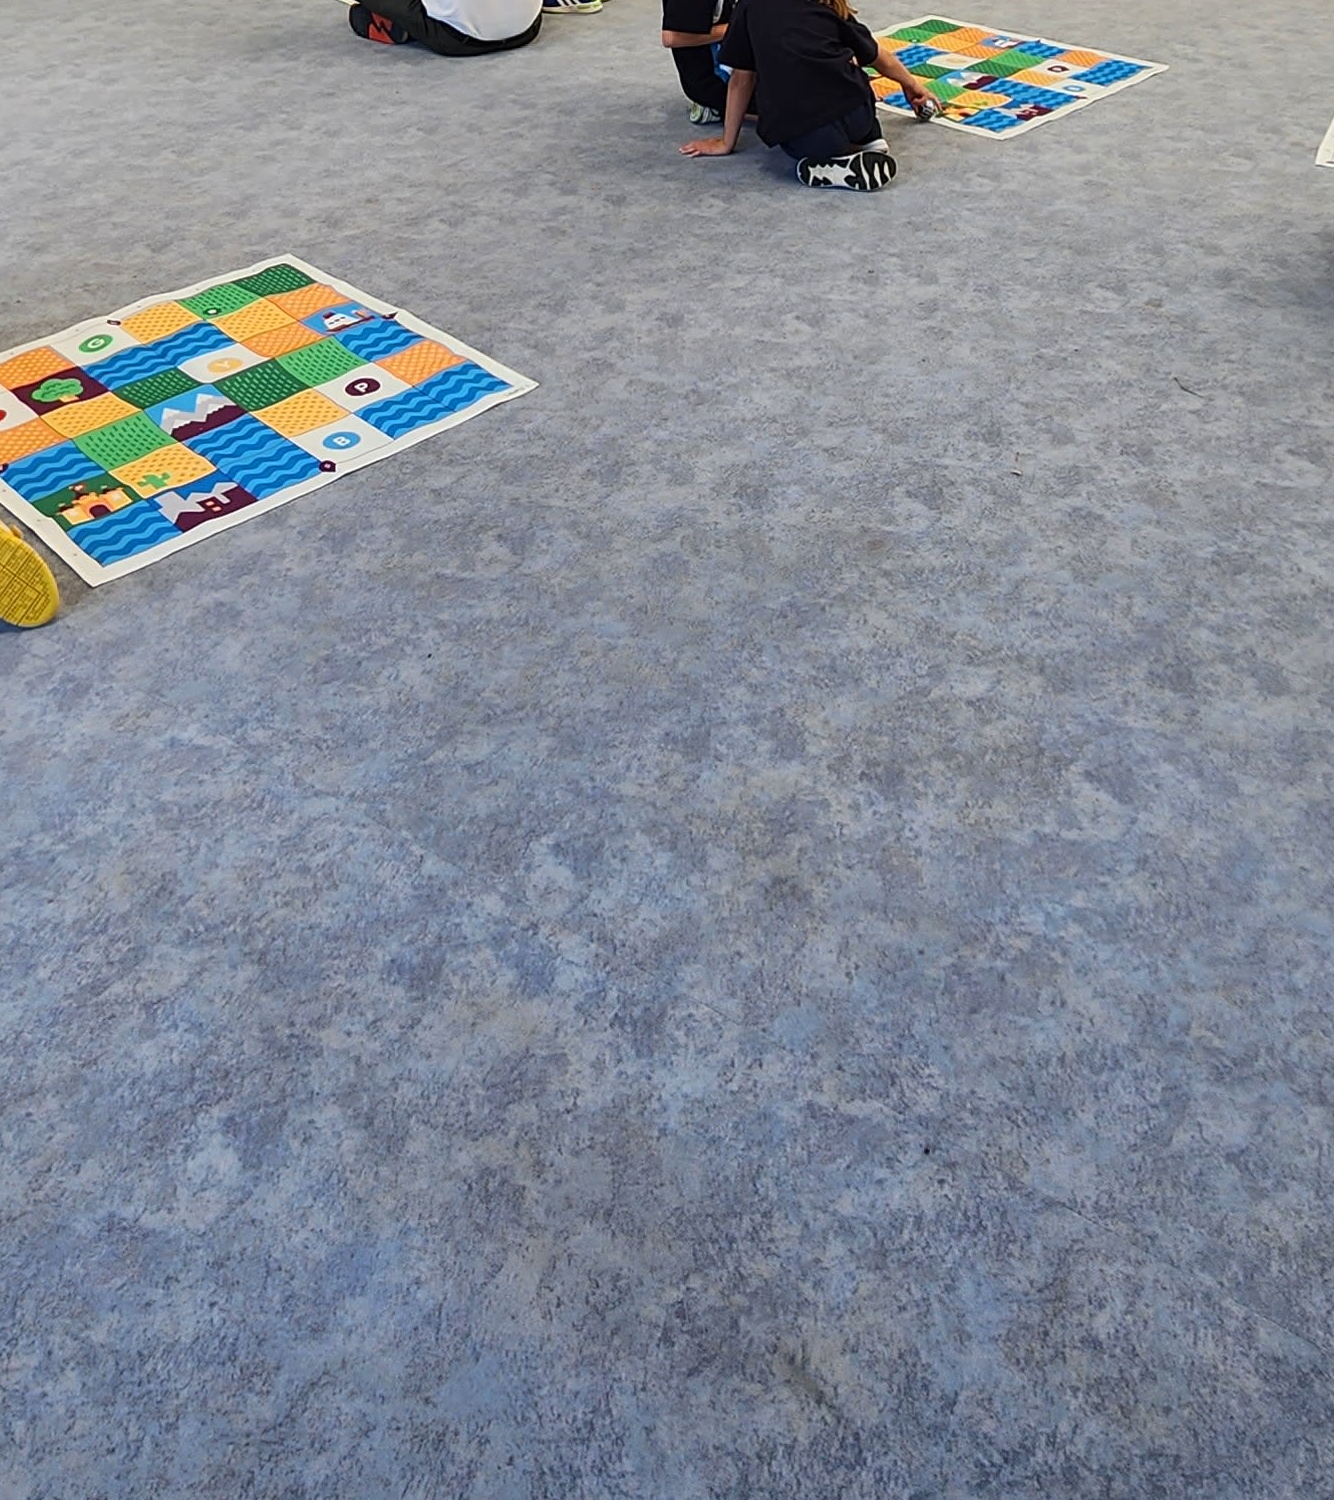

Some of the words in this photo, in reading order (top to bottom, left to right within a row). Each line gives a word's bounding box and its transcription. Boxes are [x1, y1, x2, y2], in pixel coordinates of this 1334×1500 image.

[87, 338, 105, 349] G
[353, 381, 369, 393] P
[332, 436, 351, 447] B
